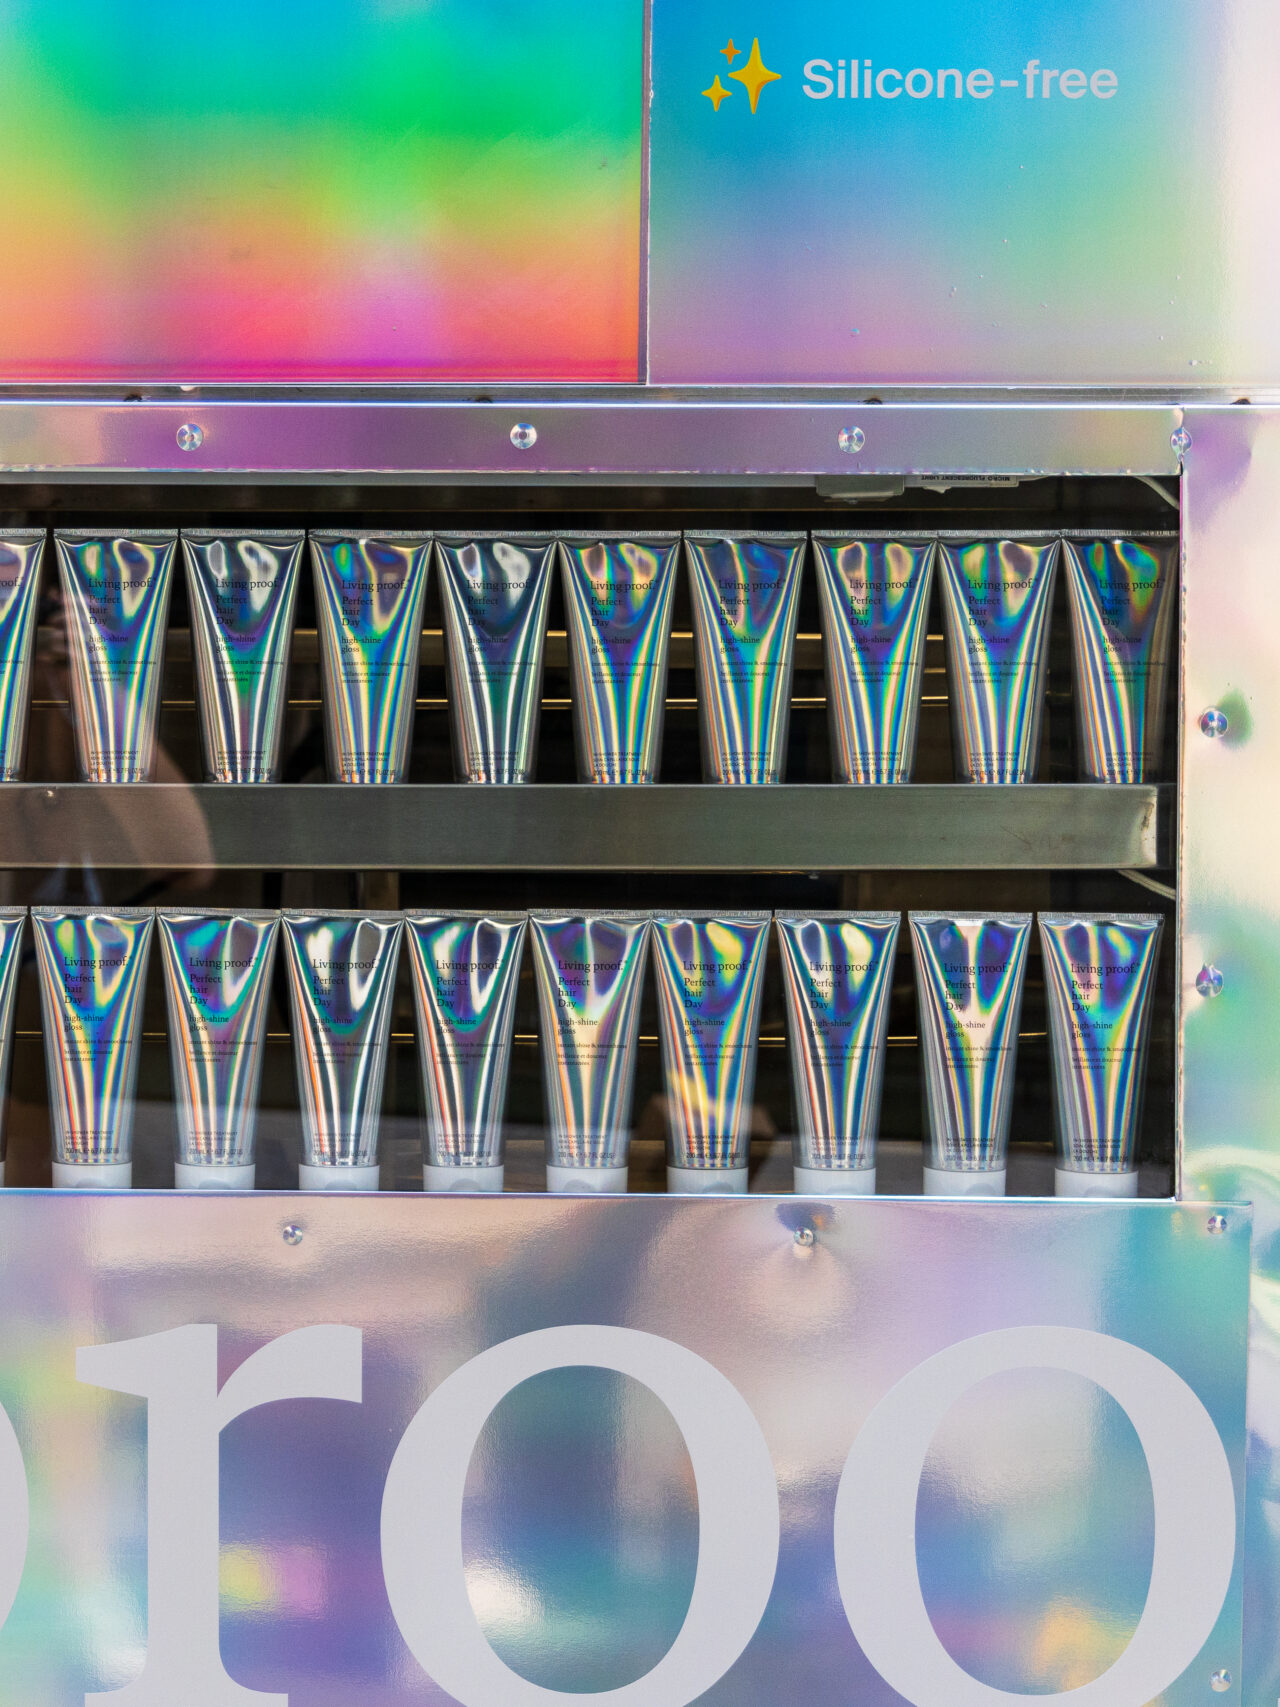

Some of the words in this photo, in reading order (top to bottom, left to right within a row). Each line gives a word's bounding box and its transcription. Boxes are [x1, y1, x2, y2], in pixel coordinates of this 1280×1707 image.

[802, 59, 1118, 99] Silicone-free
[88, 578, 121, 591] Living
[341, 579, 374, 592] Living
[589, 580, 622, 593] Living
[717, 579, 750, 592] Living
[849, 579, 882, 592] Living
[968, 579, 1001, 592] Living
[1099, 579, 1132, 592] Living
[88, 594, 120, 603] Perfect
[342, 595, 374, 604] Perfect
[591, 596, 623, 605] Perfect
[719, 595, 751, 604] Perfect
[851, 595, 883, 604] Perfect
[969, 595, 1001, 604] Perfect
[1099, 595, 1131, 604] Perfect
[88, 604, 107, 613] hair
[342, 606, 361, 615] hair
[88, 616, 107, 627] Day
[342, 617, 361, 628] Day
[63, 956, 96, 969] Living
[189, 957, 222, 970] Living
[312, 958, 345, 971] Living
[435, 959, 468, 972] Living
[558, 960, 591, 973] Living
[682, 960, 715, 973] Living
[809, 961, 842, 974] Living
[943, 962, 976, 975] Living
[1070, 963, 1103, 976] Living
[64, 973, 96, 982] Perfect
[189, 973, 221, 982] Perfect
[313, 975, 345, 984] Perfect
[436, 976, 468, 985] Perfect
[559, 976, 591, 985] Perfect
[683, 977, 715, 986] Perfect
[810, 978, 842, 987] Perfect
[64, 983, 83, 992] hair
[944, 979, 976, 988] Perfect
[1072, 980, 1104, 989] Perfect
[559, 987, 578, 996] hair
[683, 988, 702, 997] hair
[1072, 990, 1091, 999] hair
[64, 995, 83, 1006] Day
[559, 998, 578, 1009] Day
[683, 999, 702, 1010] Day
[1072, 1002, 1091, 1013] Day
